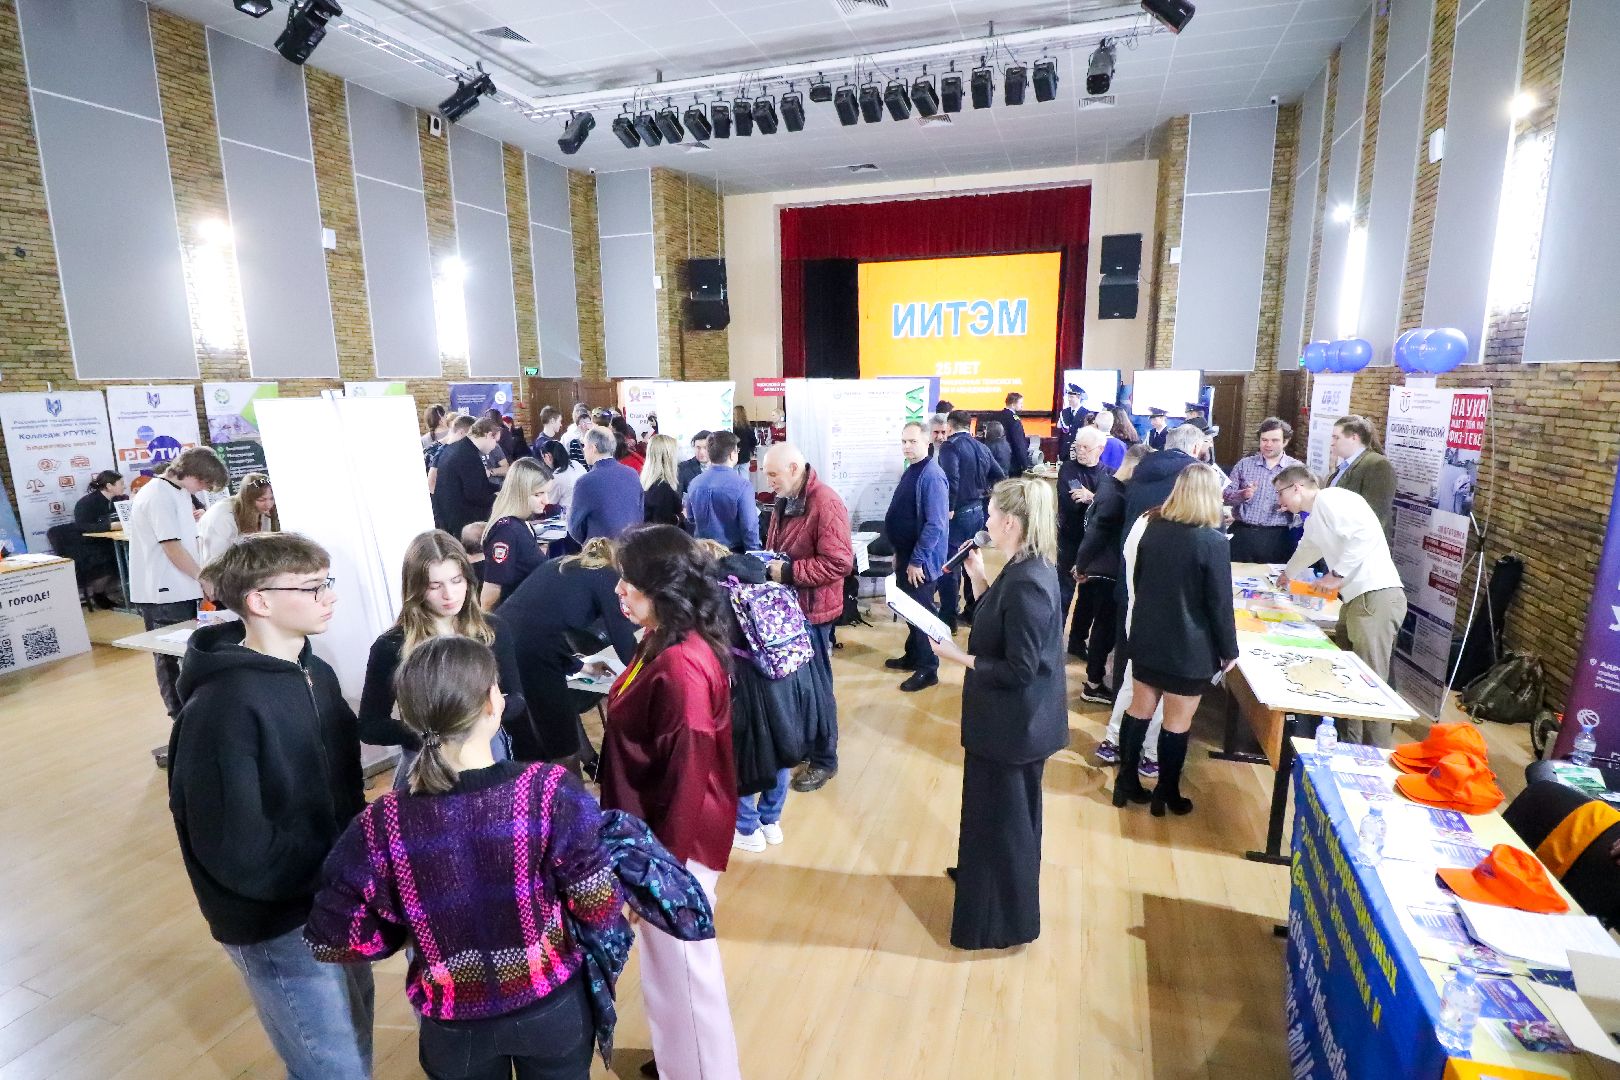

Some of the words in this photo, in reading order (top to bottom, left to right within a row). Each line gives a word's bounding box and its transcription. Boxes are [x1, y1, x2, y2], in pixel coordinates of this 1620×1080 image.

[892, 298, 1028, 338] ИИТЭМ
[935, 361, 951, 375] 25
[953, 360, 980, 375] ЛЕТ
[1452, 398, 1486, 419] НАУКА
[19, 431, 60, 440] Колледж
[63, 429, 97, 437] РГУТИС
[8, 590, 50, 607] ГОРОДЕ!
